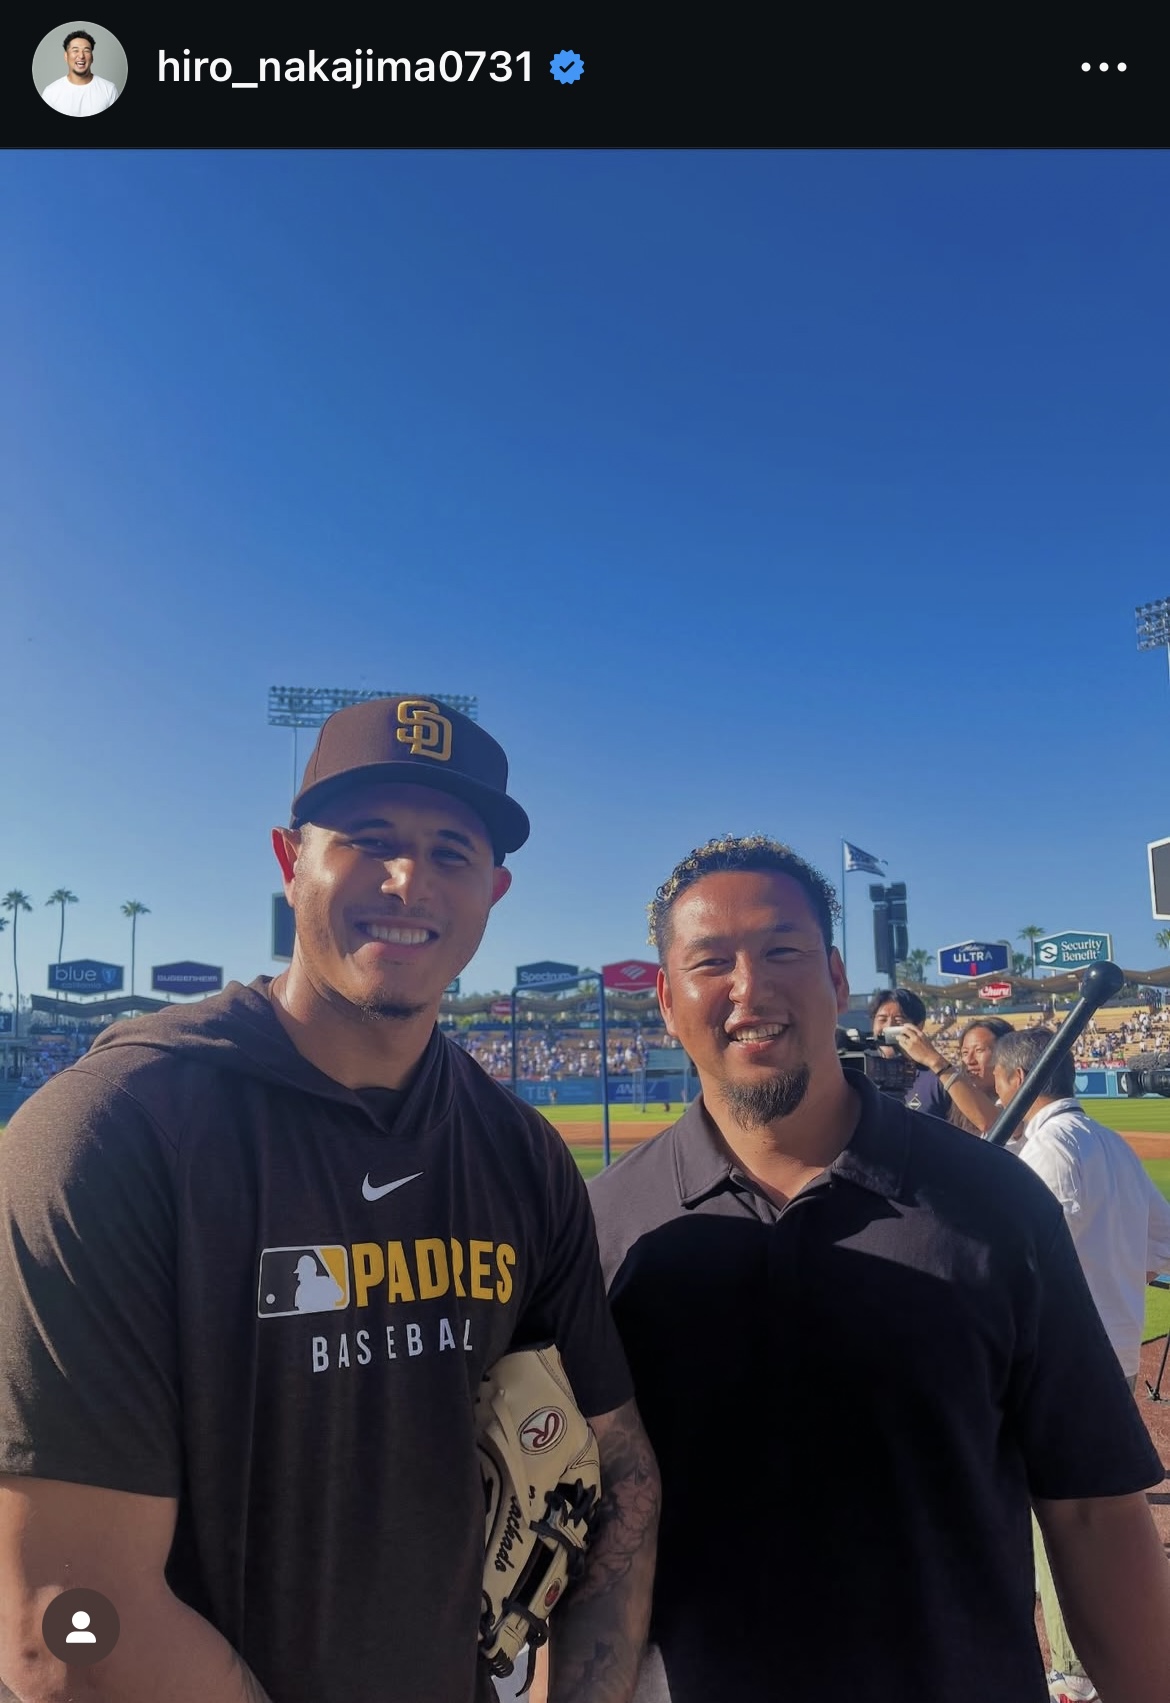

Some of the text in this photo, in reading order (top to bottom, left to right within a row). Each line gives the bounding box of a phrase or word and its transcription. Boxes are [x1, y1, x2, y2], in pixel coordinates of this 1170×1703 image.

[396, 700, 453, 762] SD
[1060, 939, 1102, 953] Security
[953, 951, 993, 963] ULTRA
[1062, 950, 1098, 962] Benefit
[55, 966, 97, 982] blue
[520, 971, 572, 983] Spectrum
[494, 1494, 524, 1573] achado
